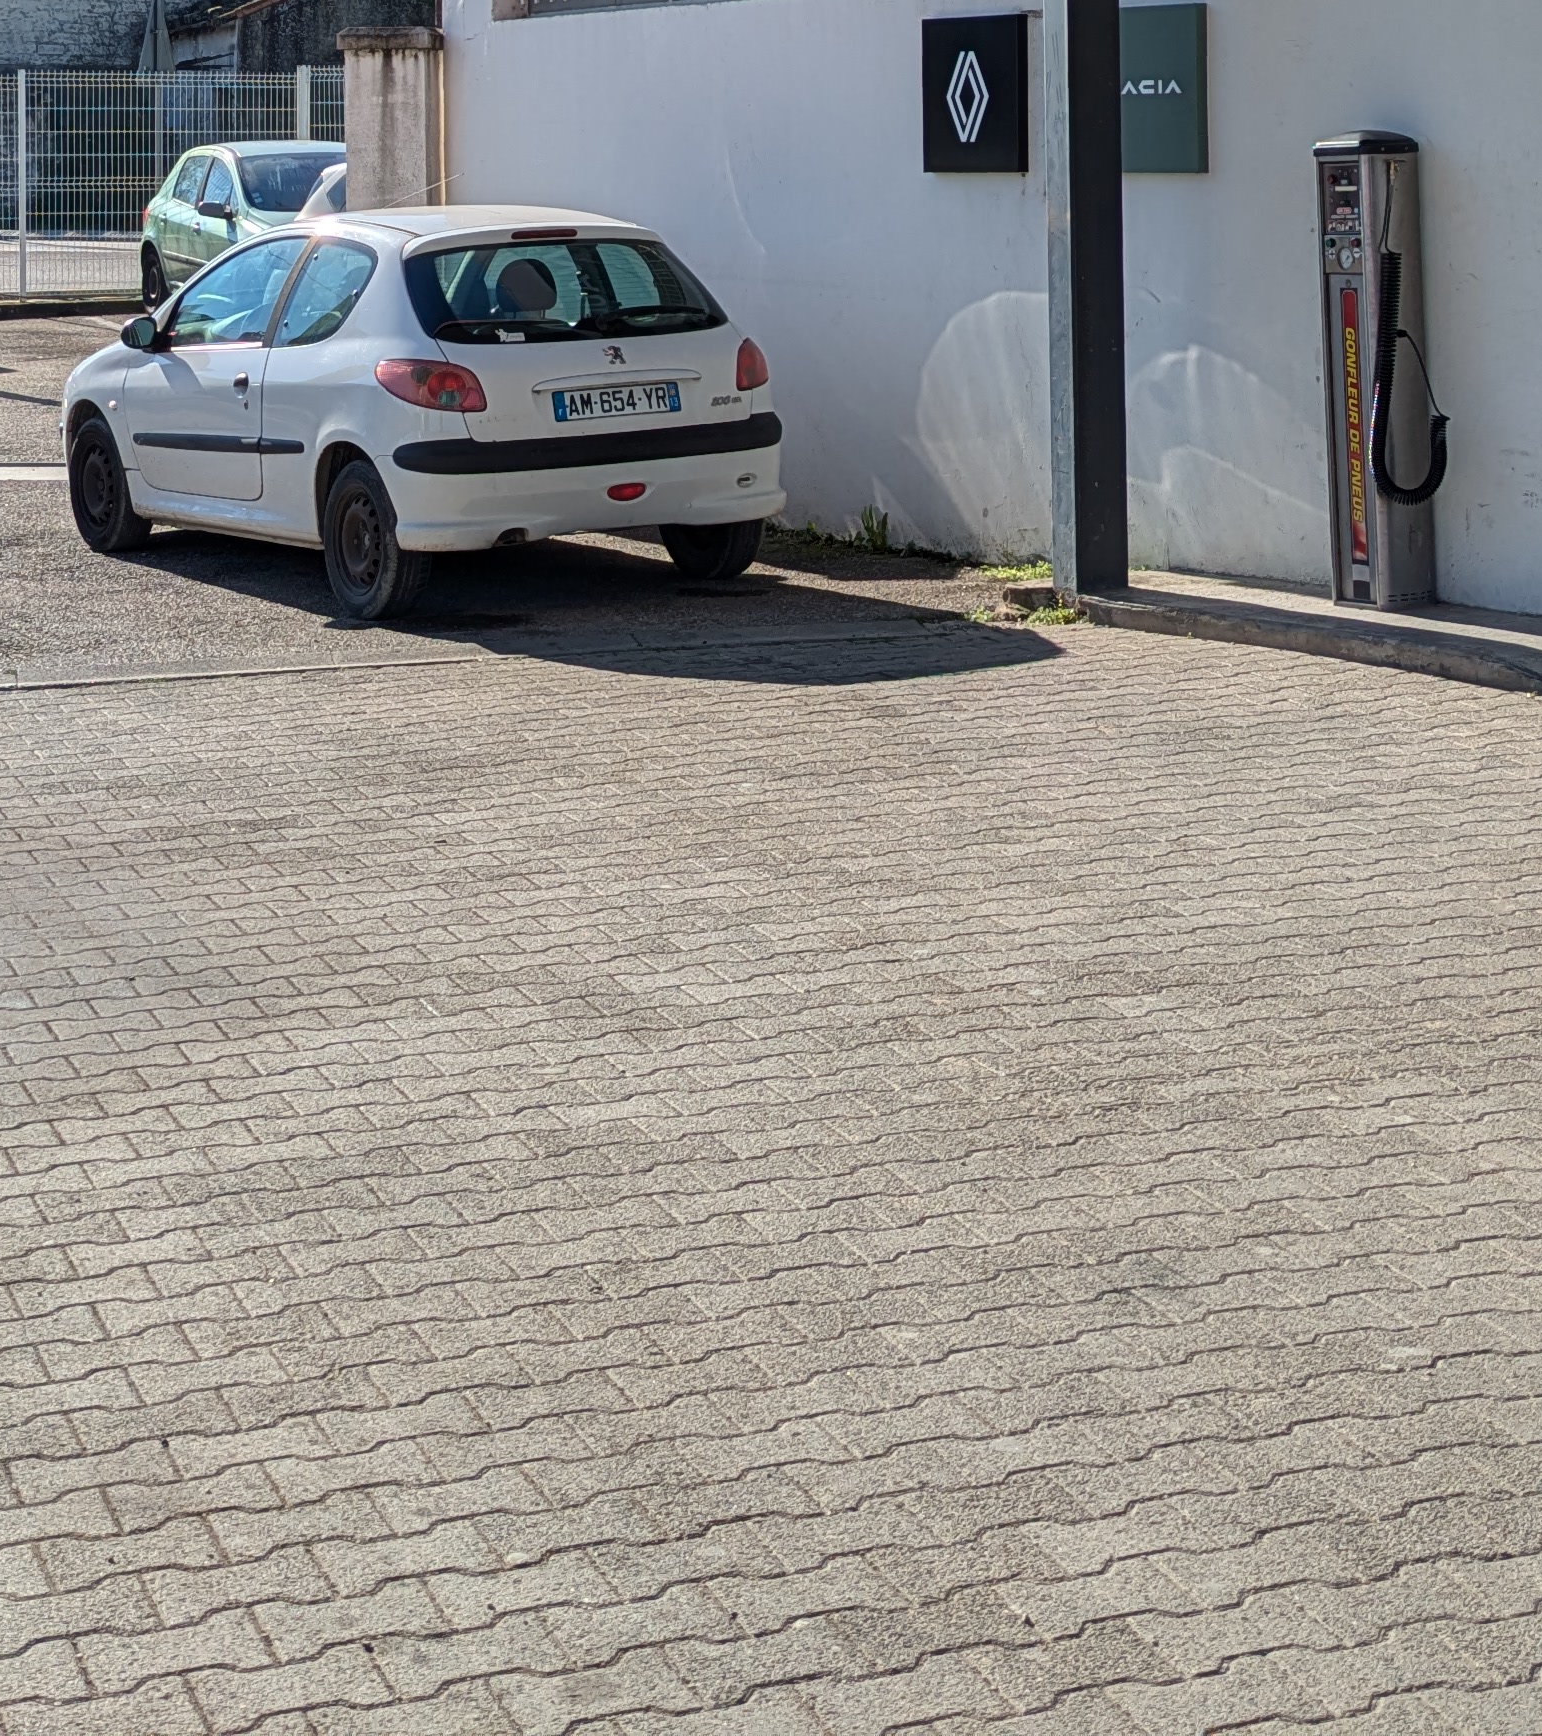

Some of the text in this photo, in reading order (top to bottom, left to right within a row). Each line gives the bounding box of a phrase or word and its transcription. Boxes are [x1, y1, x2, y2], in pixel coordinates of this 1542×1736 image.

[1120, 79, 1183, 95] ACIA
[1345, 326, 1364, 523] GONFLEUR DE PNEUS
